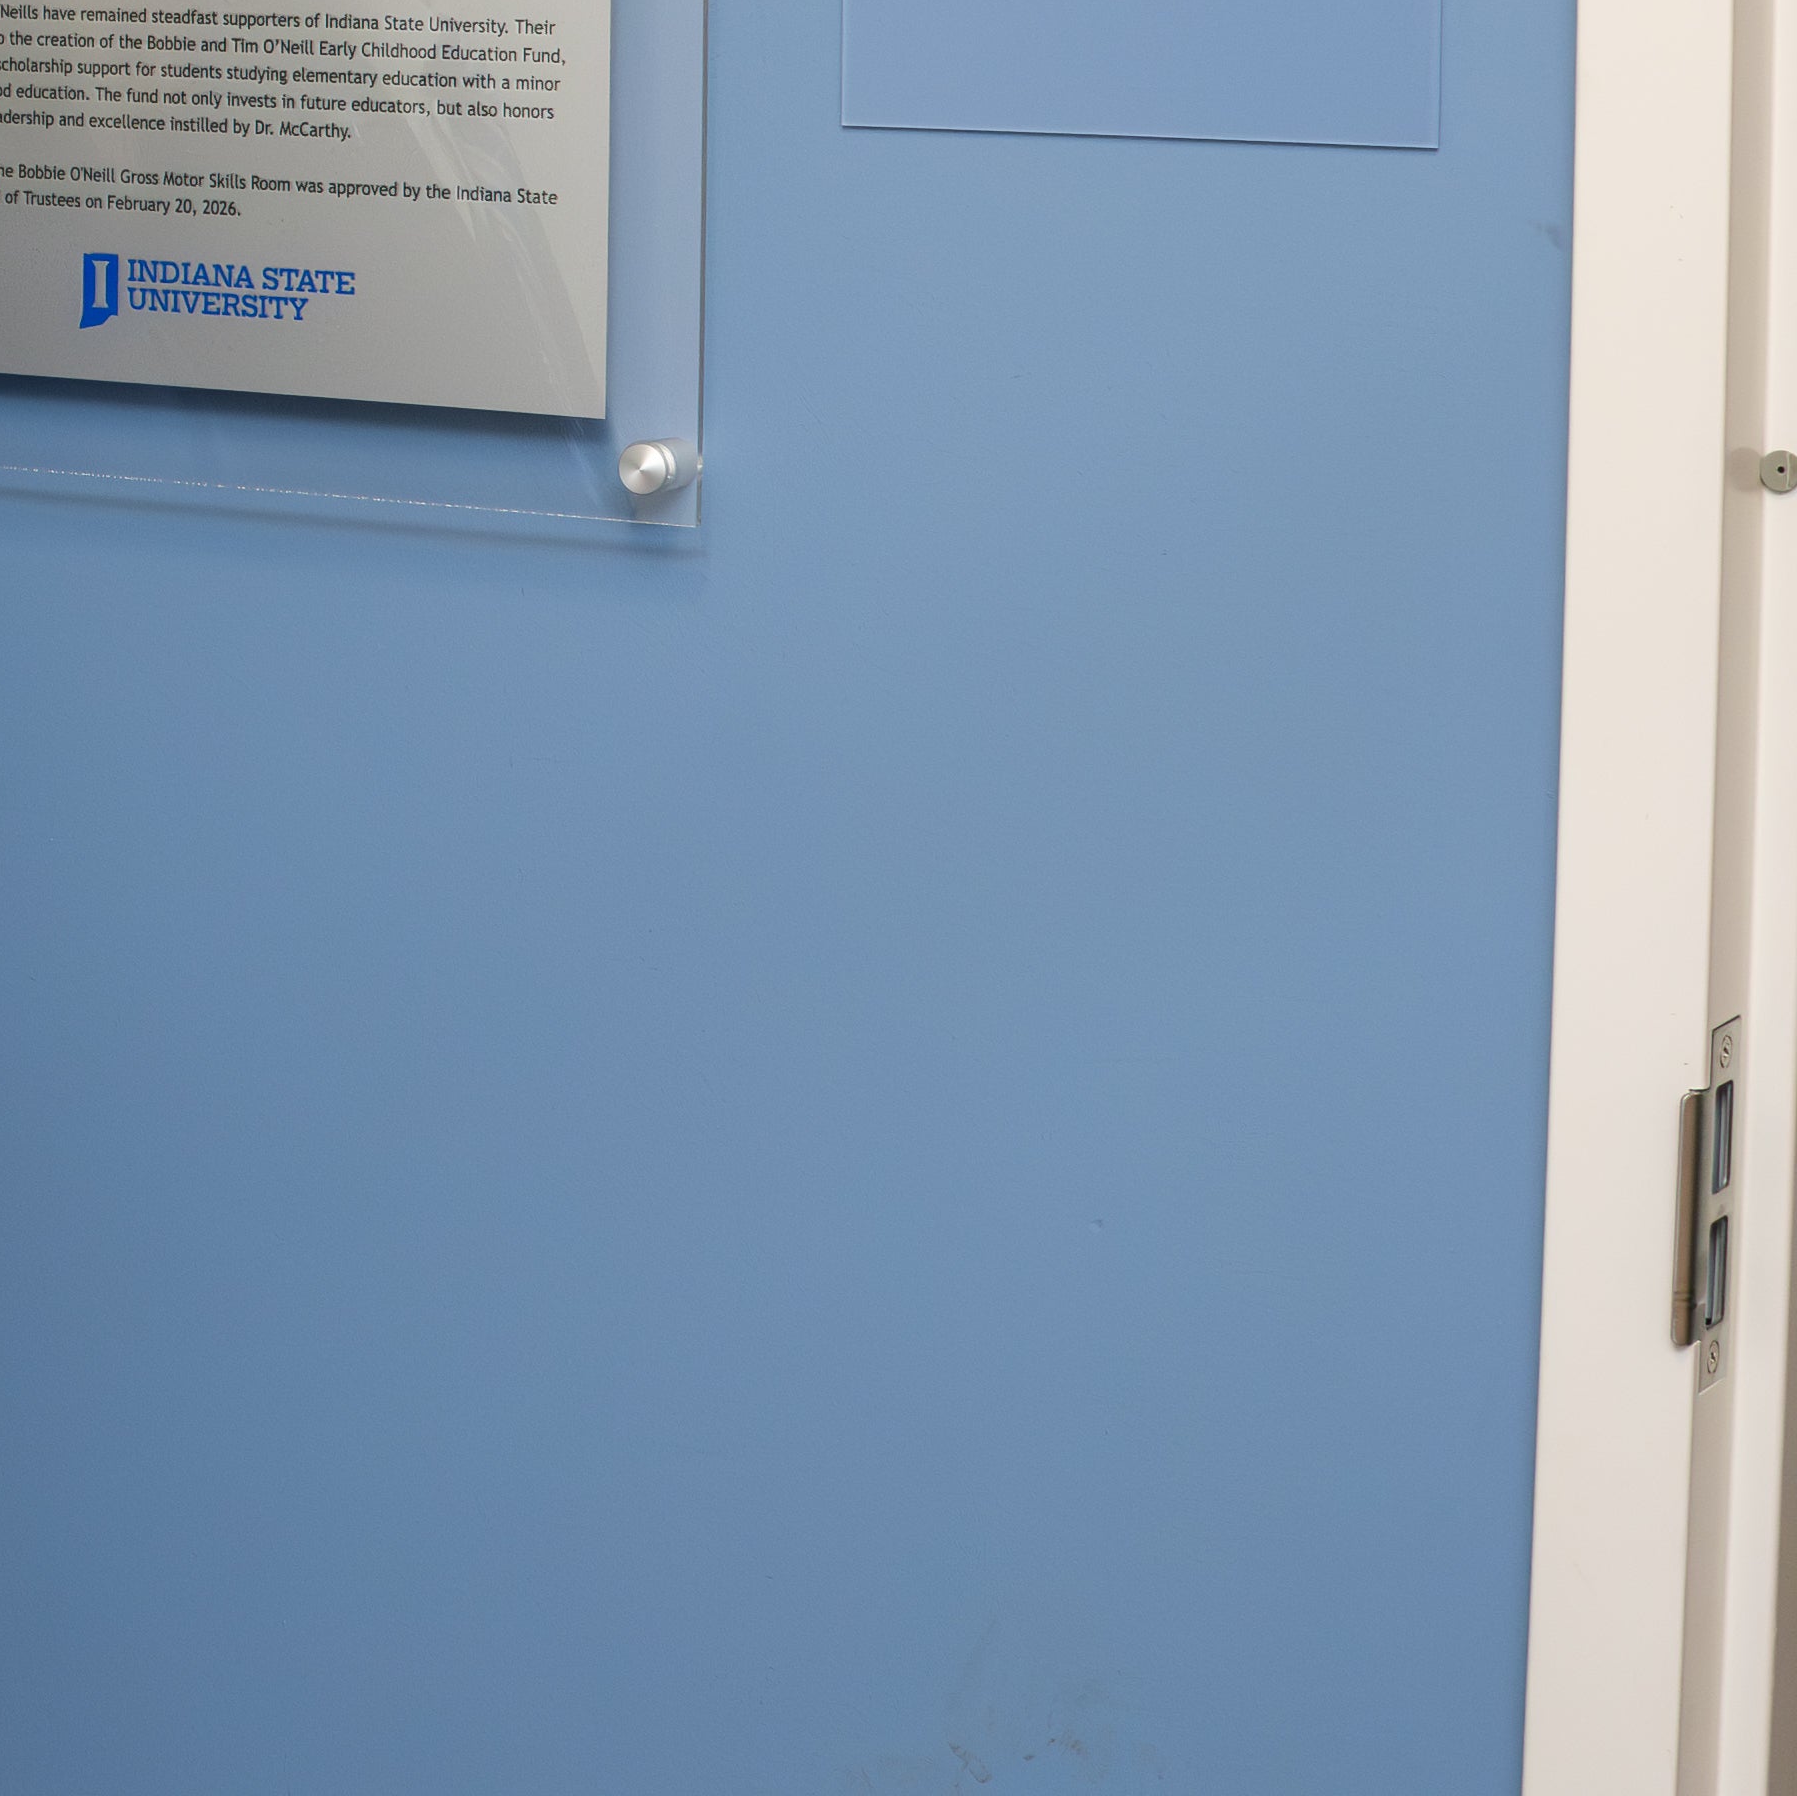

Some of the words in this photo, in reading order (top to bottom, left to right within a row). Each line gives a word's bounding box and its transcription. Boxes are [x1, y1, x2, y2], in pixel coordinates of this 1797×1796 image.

[77, 61, 132, 78] support
[135, 60, 157, 77] for
[160, 62, 223, 80] students
[226, 64, 290, 86] studying
[291, 66, 379, 88] elementary
[382, 69, 459, 88] education
[461, 72, 496, 90] with
[501, 77, 511, 90] a
[515, 74, 561, 92] minor
[58, 111, 85, 127] and
[88, 113, 167, 131] excellence
[169, 115, 229, 134] instilled
[232, 117, 251, 138] by
[255, 119, 275, 136] Dr.
[279, 120, 352, 142] McCarthy.
[4, 188, 21, 205] of
[22, 188, 81, 208] Trustees
[85, 196, 105, 209] on
[107, 193, 171, 216] February
[174, 197, 197, 217] 20,
[201, 198, 242, 217] 2026.
[127, 259, 254, 289] INDIANA
[261, 267, 356, 295] STATE
[128, 288, 308, 321] UNIVERSITY
